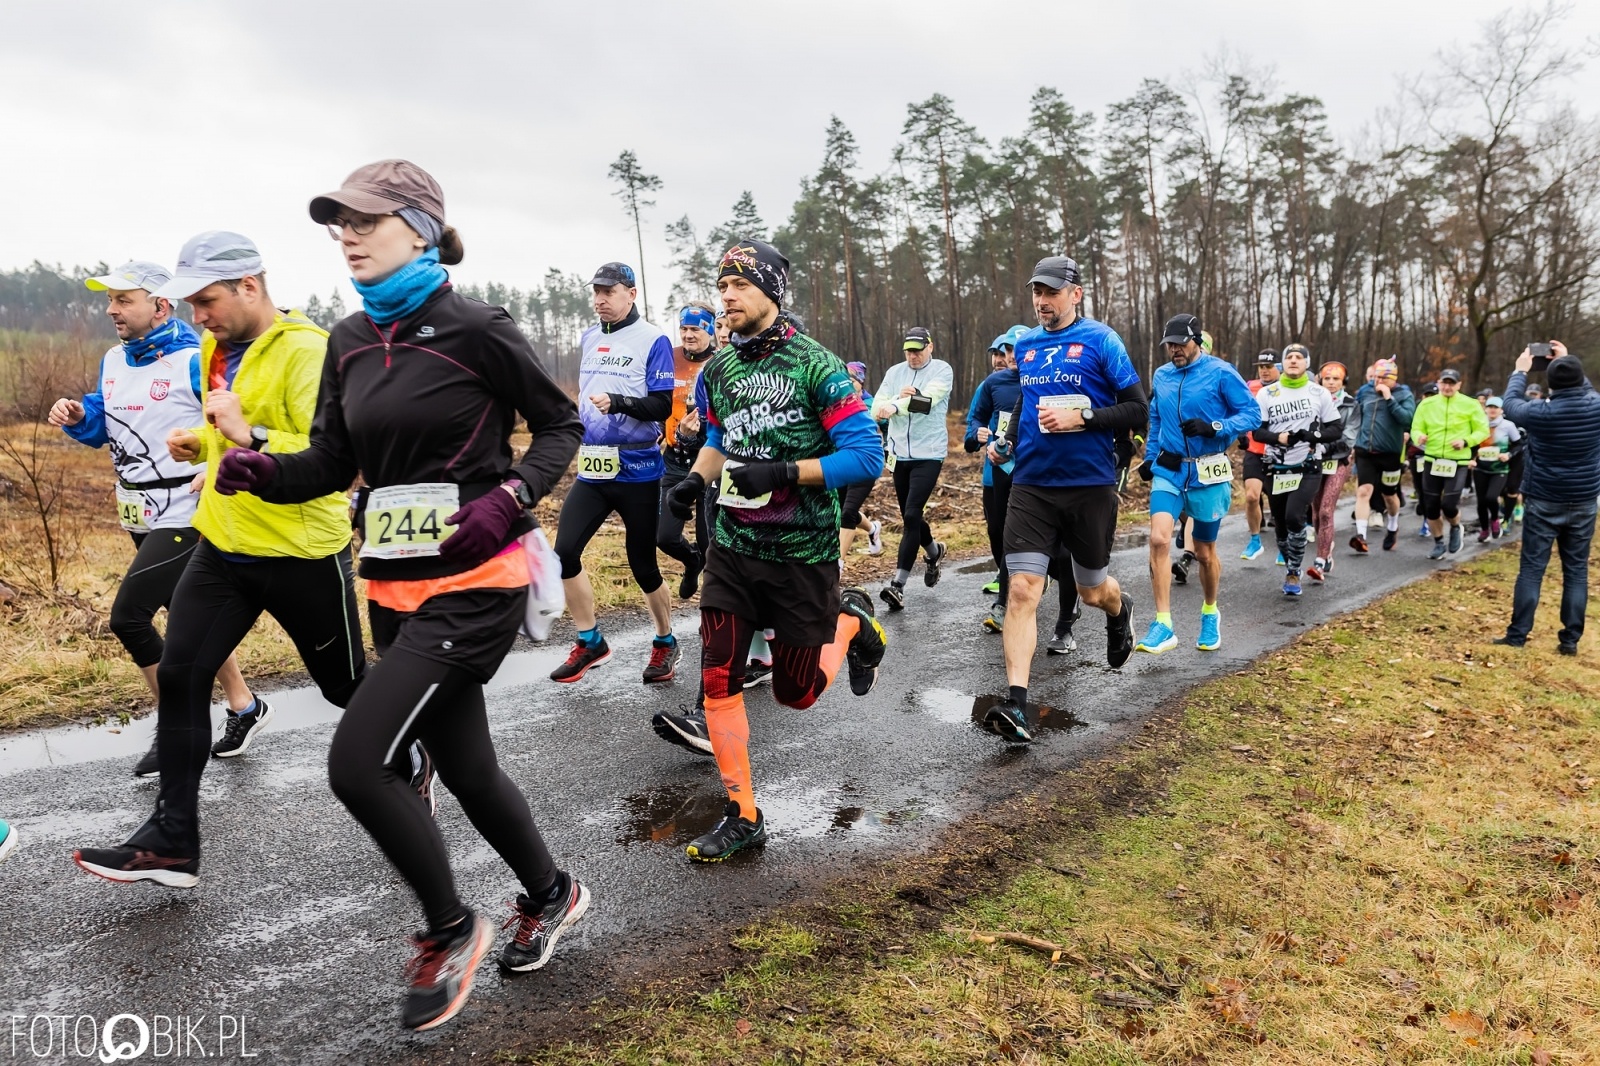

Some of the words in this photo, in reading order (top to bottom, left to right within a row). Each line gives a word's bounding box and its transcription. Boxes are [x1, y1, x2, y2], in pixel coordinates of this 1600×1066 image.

[1054, 367, 1082, 387] Żory
[723, 408, 750, 431] BIEG
[751, 402, 771, 418] PO
[744, 407, 806, 436] PAPROCI
[584, 457, 614, 472] 205
[624, 460, 656, 470] respirea
[1204, 462, 1228, 478] 164
[1435, 464, 1452, 473] 214
[1279, 479, 1297, 490] 159
[119, 503, 139, 525] 49
[378, 509, 442, 544] 244
